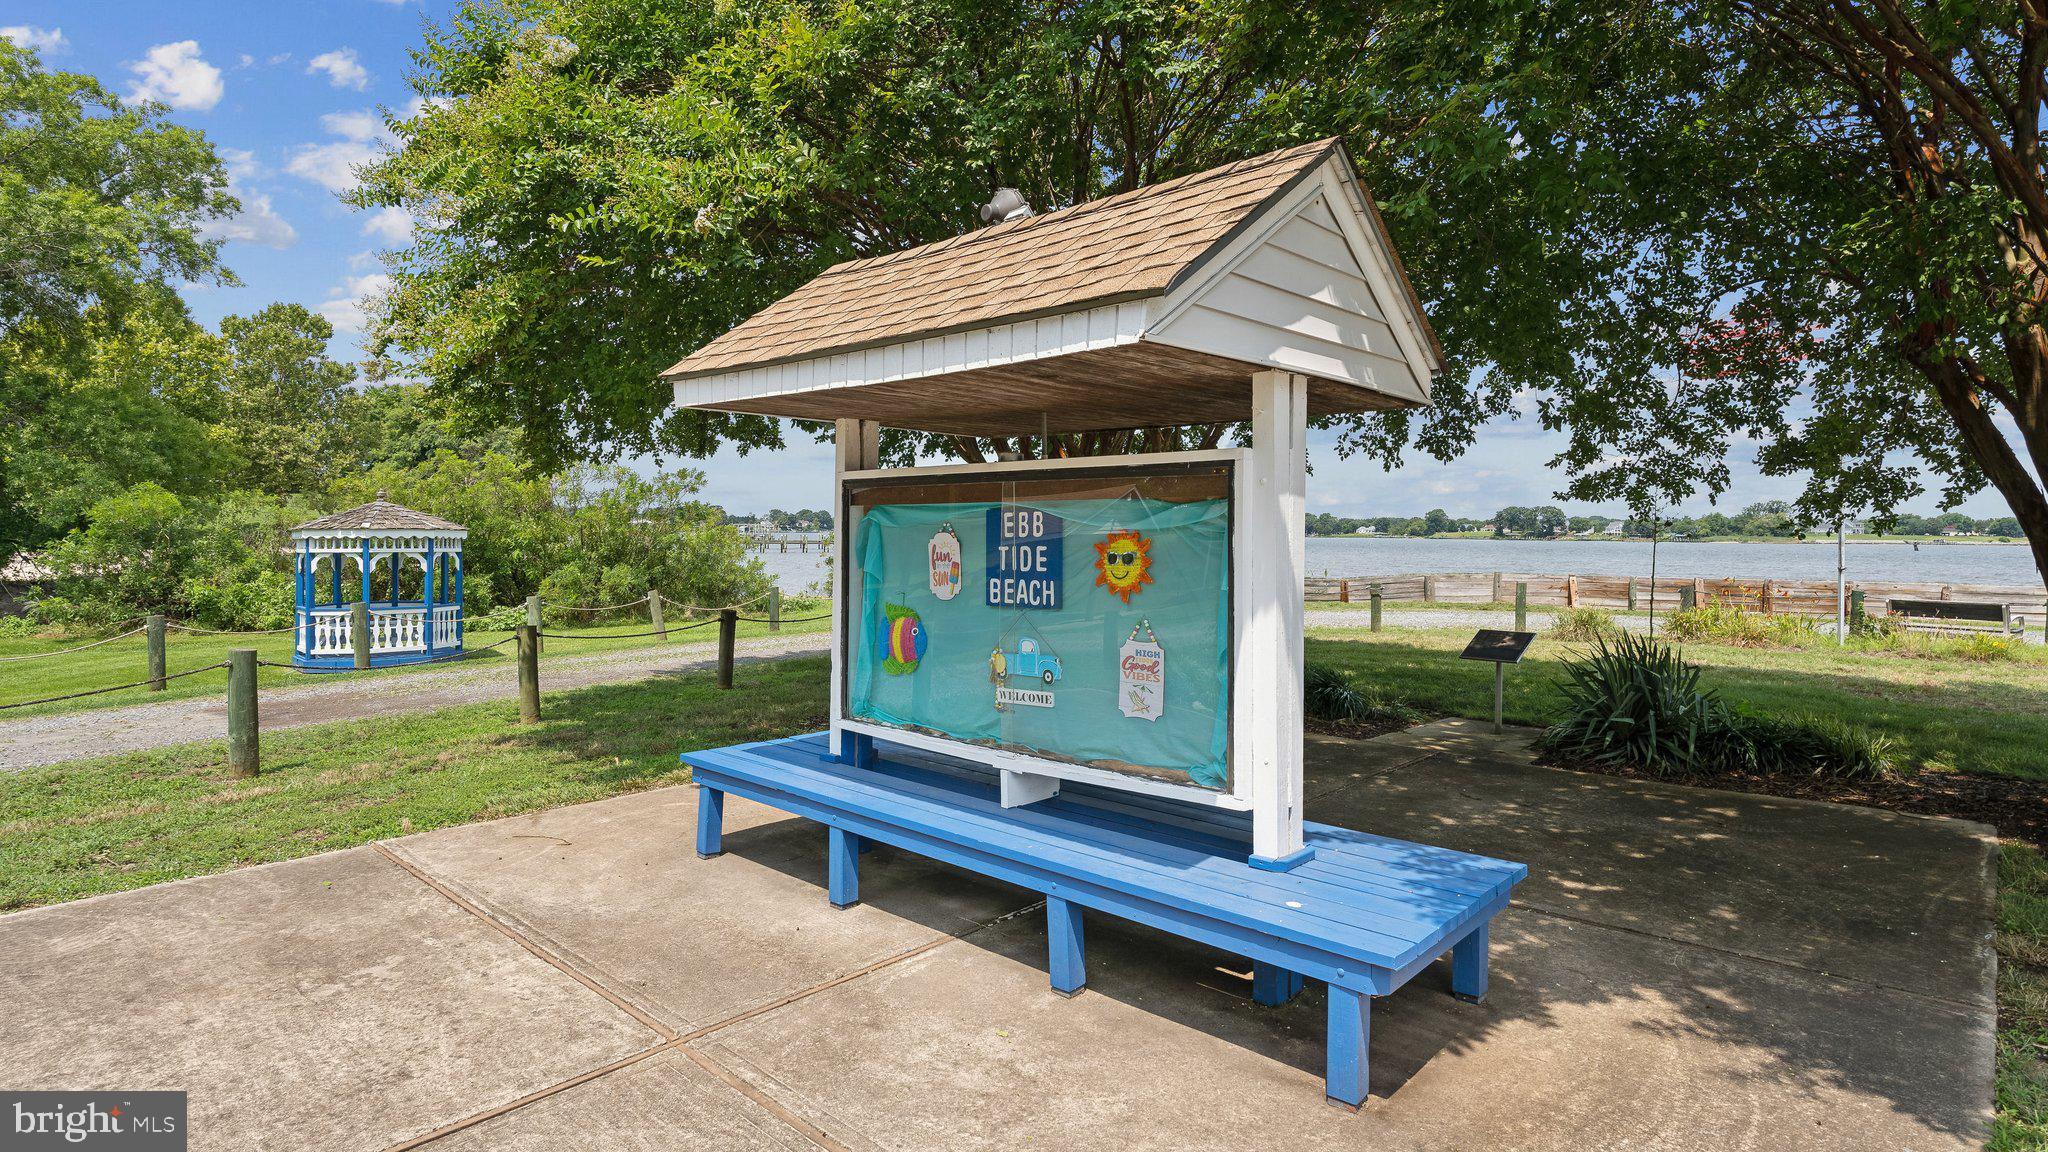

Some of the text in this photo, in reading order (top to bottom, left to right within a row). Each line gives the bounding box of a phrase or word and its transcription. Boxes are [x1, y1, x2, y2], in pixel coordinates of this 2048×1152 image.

[1003, 511, 1044, 538] EBB
[931, 544, 952, 570] fun
[998, 545, 1047, 572] TIDE
[989, 578, 1055, 607] BEACH
[1121, 655, 1160, 674] Good
[1135, 649, 1160, 659] HIGH
[1122, 671, 1161, 683] VIBES
[999, 690, 1052, 705] WELCOME
